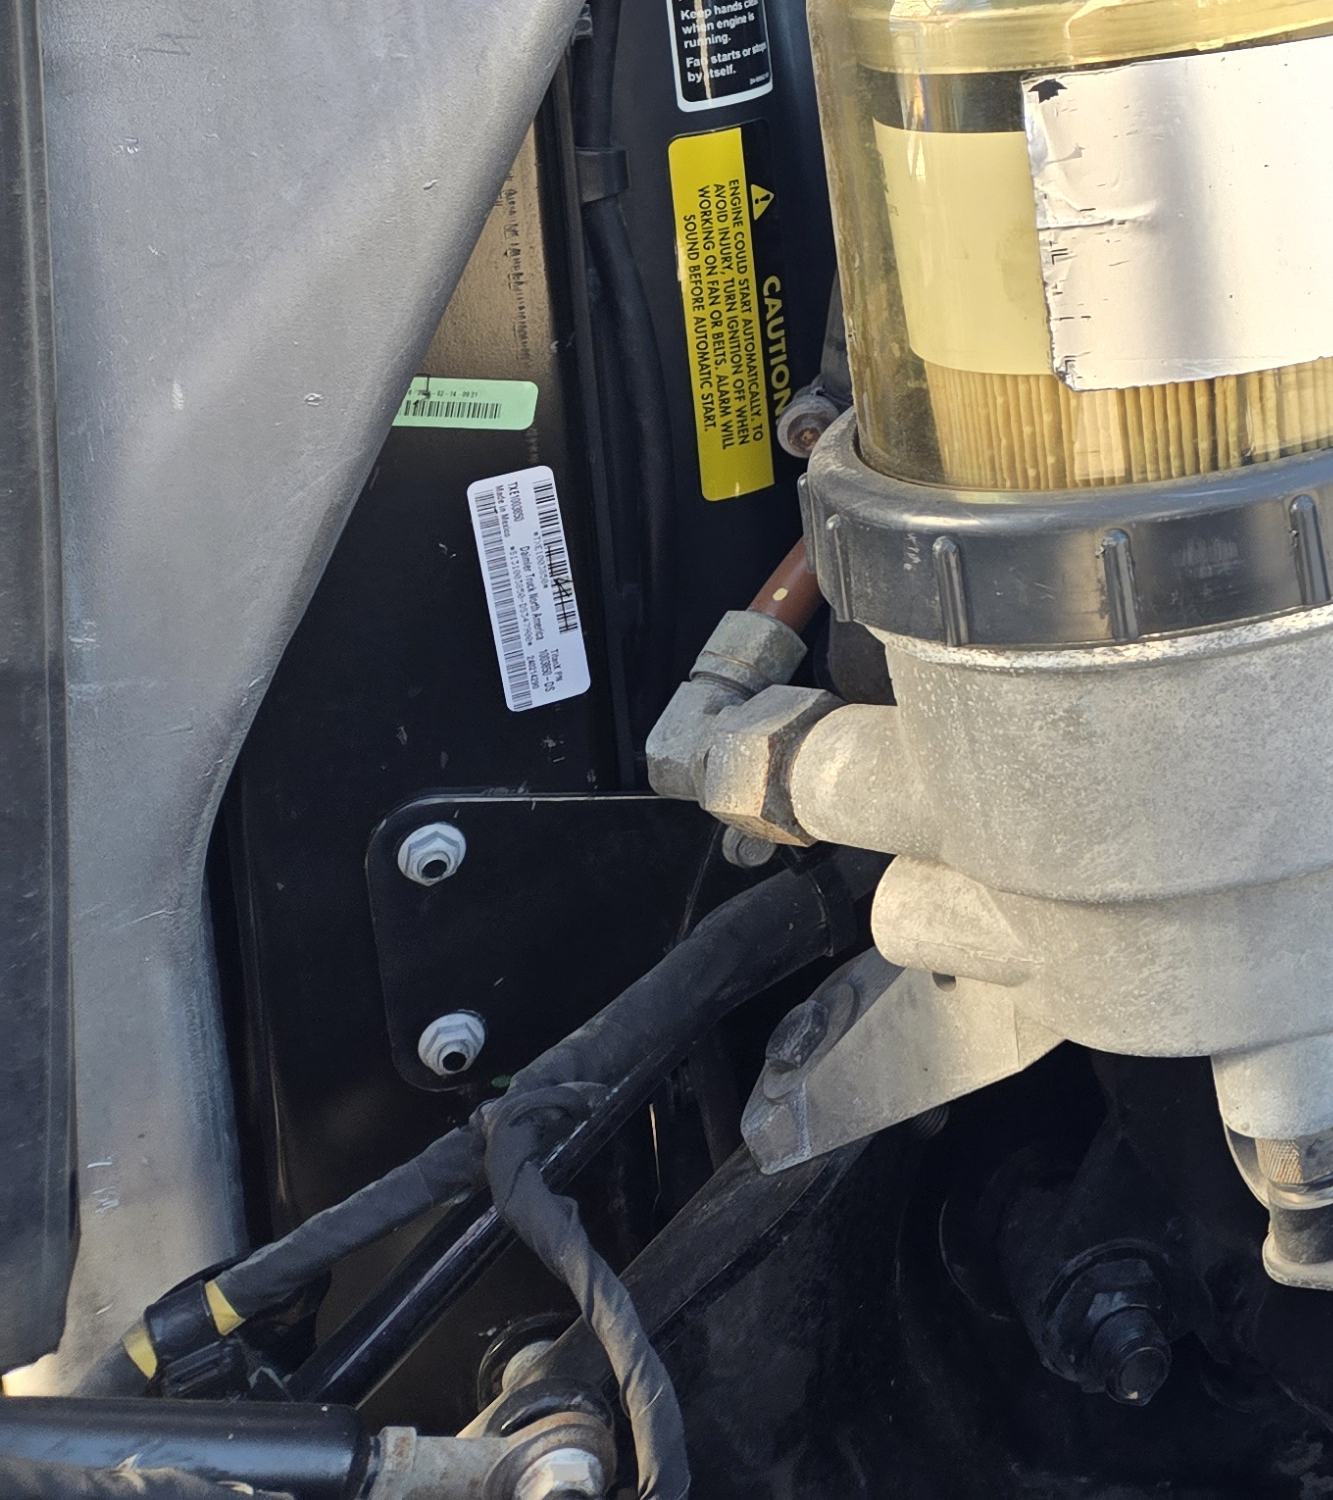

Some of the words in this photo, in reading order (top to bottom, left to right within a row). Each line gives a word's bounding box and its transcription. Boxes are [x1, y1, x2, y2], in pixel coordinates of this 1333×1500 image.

[714, 1, 742, 15] hands
[717, 16, 747, 29] engine
[748, 12, 755, 21] is
[711, 49, 741, 64] starts
[742, 47, 751, 57] or
[687, 71, 702, 83] by
[704, 64, 736, 79] tself.
[695, 186, 716, 250] WORKING
[712, 182, 729, 223] AVOID
[726, 179, 744, 227] ENGINE
[681, 214, 700, 261] SOUND
[714, 226, 734, 275] INJURY,
[731, 230, 749, 274] COULD
[703, 254, 718, 276] ON
[686, 264, 705, 311] BEFORE
[705, 279, 721, 306] FAN
[720, 277, 737, 312] TURN
[736, 278, 752, 313] START
[708, 309, 723, 329] OR
[691, 314, 714, 389] AUTOMATIC
[710, 332, 727, 370] BELTS.
[724, 315, 744, 376] IGNITION
[738, 317, 764, 421] AUTOMATICALLY.
[713, 373, 732, 417] ALARM
[731, 378, 746, 402] OFF
[699, 392, 717, 432] START.
[733, 404, 750, 445] WHEN
[718, 420, 734, 449] WILL
[750, 423, 764, 441] TO
[494, 484, 506, 505] Made
[498, 504, 508, 513] in
[507, 481, 523, 522] TXE1003850
[499, 513, 512, 537] Mexico
[519, 545, 532, 572] Daimler
[523, 573, 536, 592] Truck
[527, 593, 540, 613] North
[531, 613, 545, 641] America
[537, 648, 554, 692] 1003850-DS
[549, 648, 561, 670] TitanX
